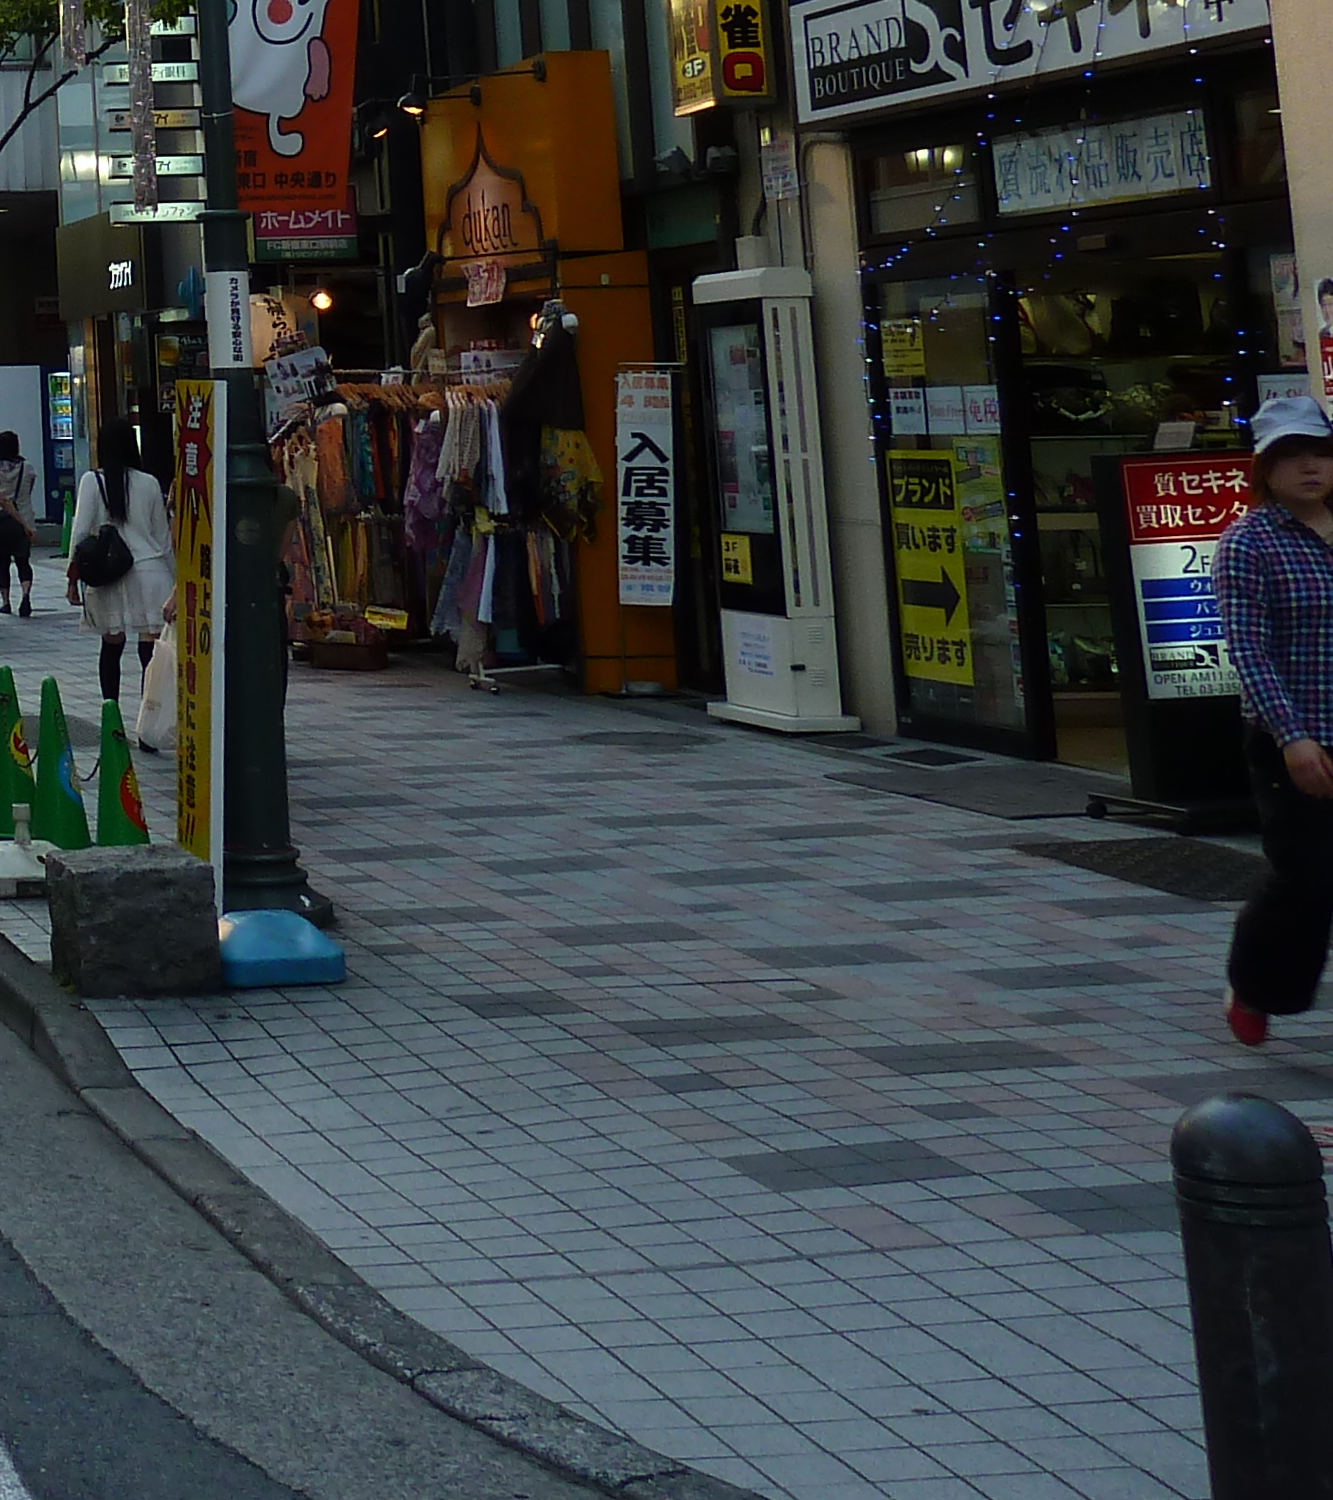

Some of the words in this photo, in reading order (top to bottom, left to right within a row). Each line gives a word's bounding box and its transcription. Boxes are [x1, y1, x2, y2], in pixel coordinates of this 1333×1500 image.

[809, 15, 904, 68] BRAND
[684, 58, 703, 78] 3F
[814, 56, 907, 100] BOUTIQUE
[997, 118, 1208, 202] 質流れ品販売店
[274, 171, 337, 189] 中央通り
[260, 210, 351, 230] ホームメイト
[462, 192, 520, 255] dukan
[892, 476, 953, 503] ブランド
[1153, 468, 1250, 497] 質セキネ
[620, 431, 672, 568] 入居募集
[895, 520, 959, 554] 買います
[1180, 544, 1210, 575] 2F
[904, 631, 968, 668] 売ります
[1154, 670, 1190, 684] OPEN
[1174, 684, 1199, 696] TEL
